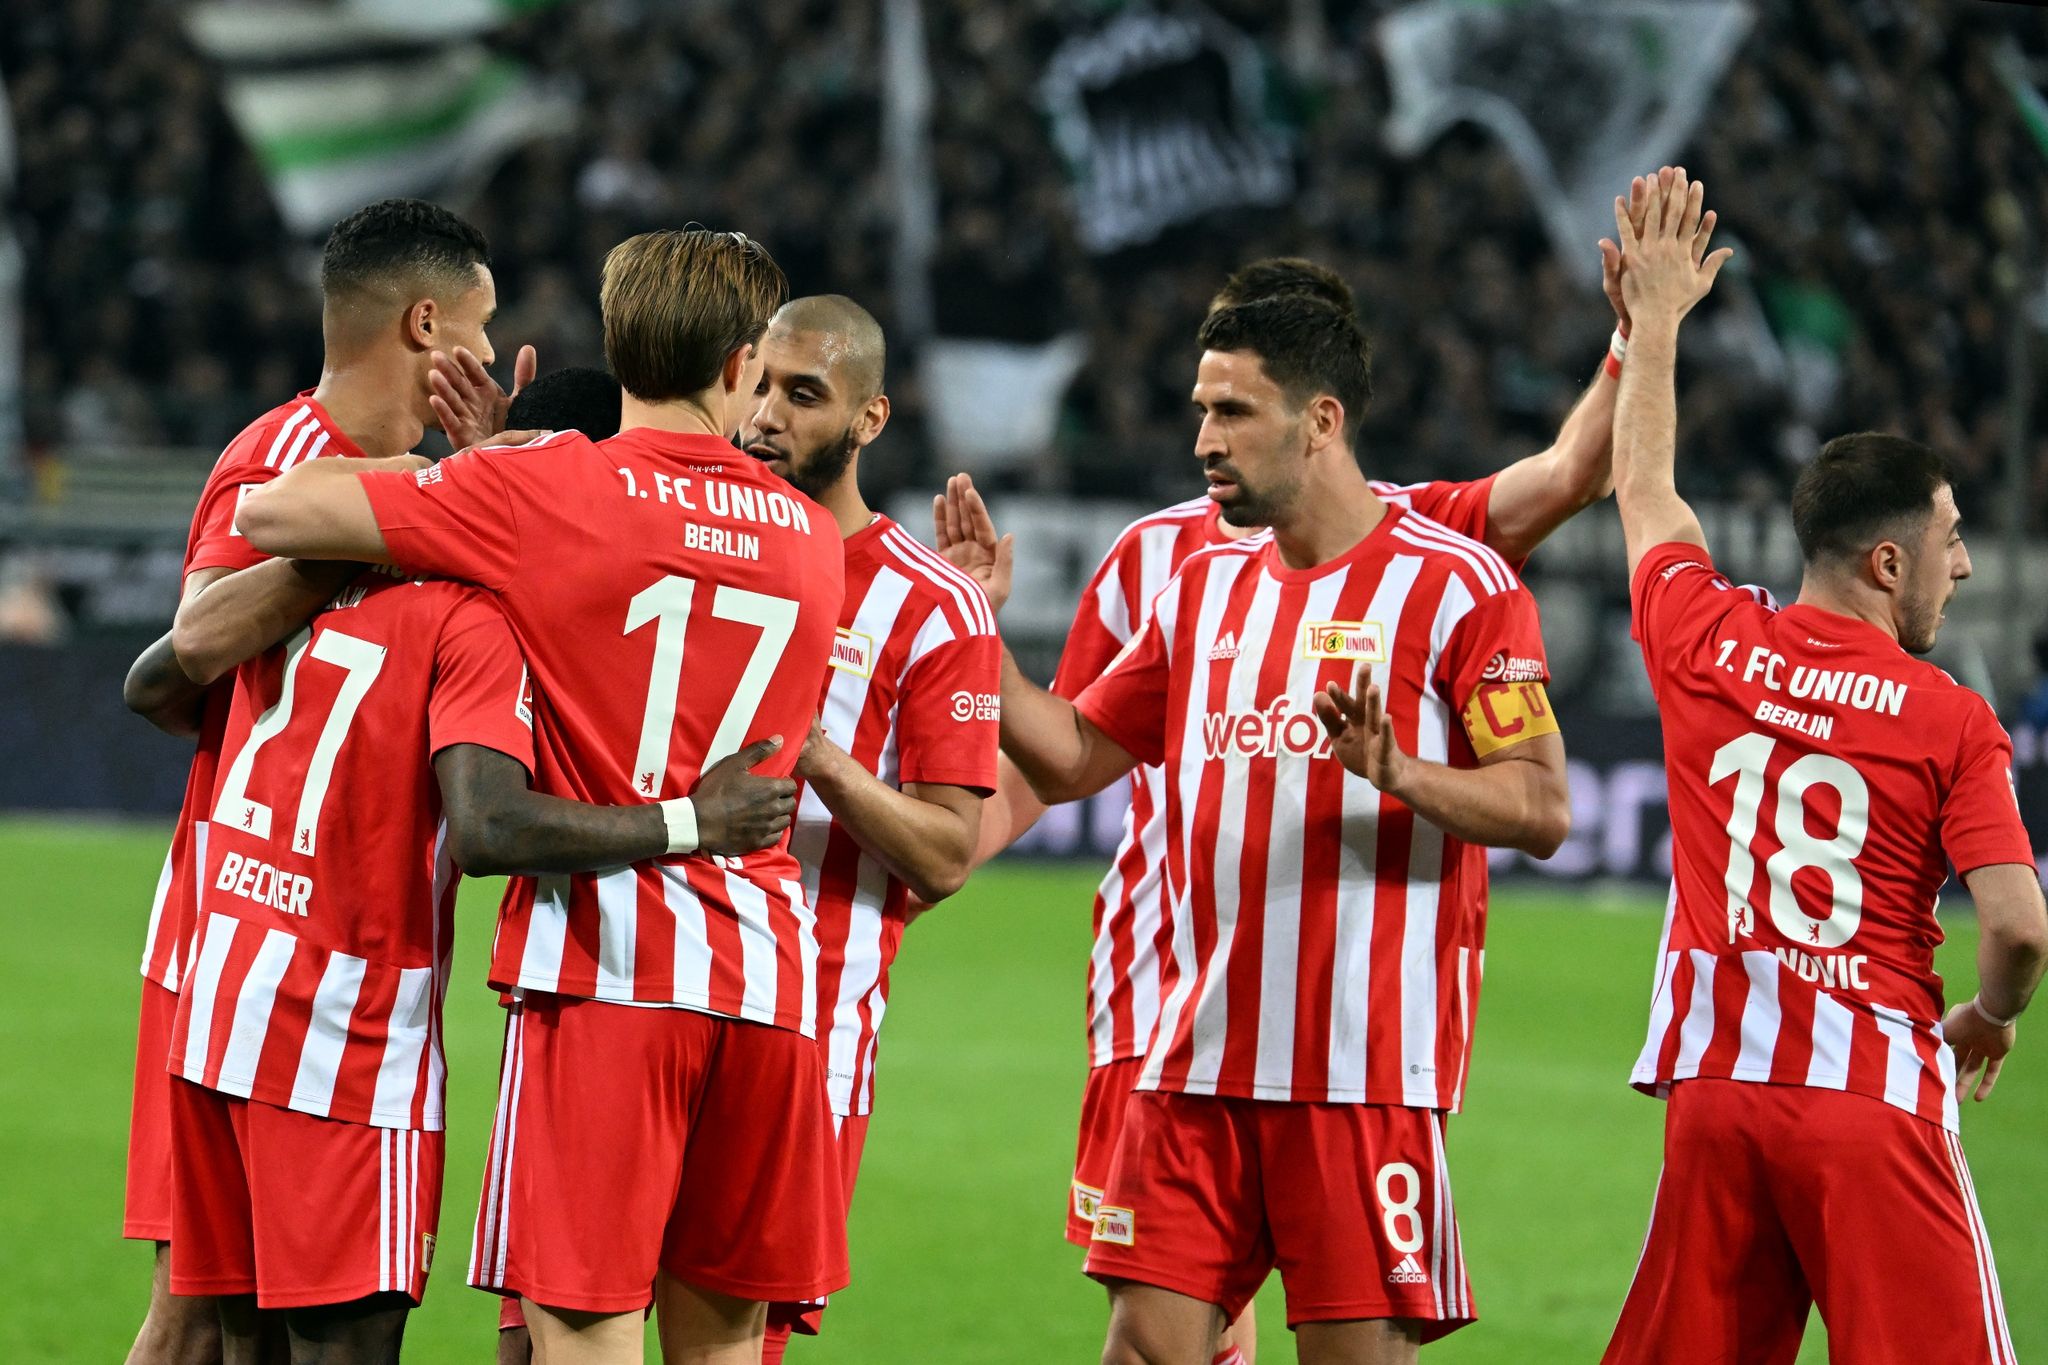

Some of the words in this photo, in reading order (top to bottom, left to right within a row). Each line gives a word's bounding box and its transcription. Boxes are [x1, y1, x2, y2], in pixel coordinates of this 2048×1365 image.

[618, 467, 648, 499] 1.
[652, 471, 697, 510] FC
[705, 480, 812, 535] UNION
[684, 522, 759, 561] BERLIN
[1207, 647, 1240, 661] adidas
[1345, 636, 1376, 652] UNION
[623, 574, 800, 799] 17
[975, 693, 1000, 708] COM
[1715, 639, 1738, 672] 1.
[1743, 646, 1787, 691] FC
[1788, 666, 1909, 716] UNION
[212, 624, 387, 858] 27
[1754, 700, 1834, 741] BERLIN
[1708, 732, 1869, 948] 18
[215, 851, 314, 917] BECKER
[1775, 947, 1870, 990] NOVIC
[1376, 1162, 1425, 1254] 8
[1387, 1272, 1428, 1285] adidas
